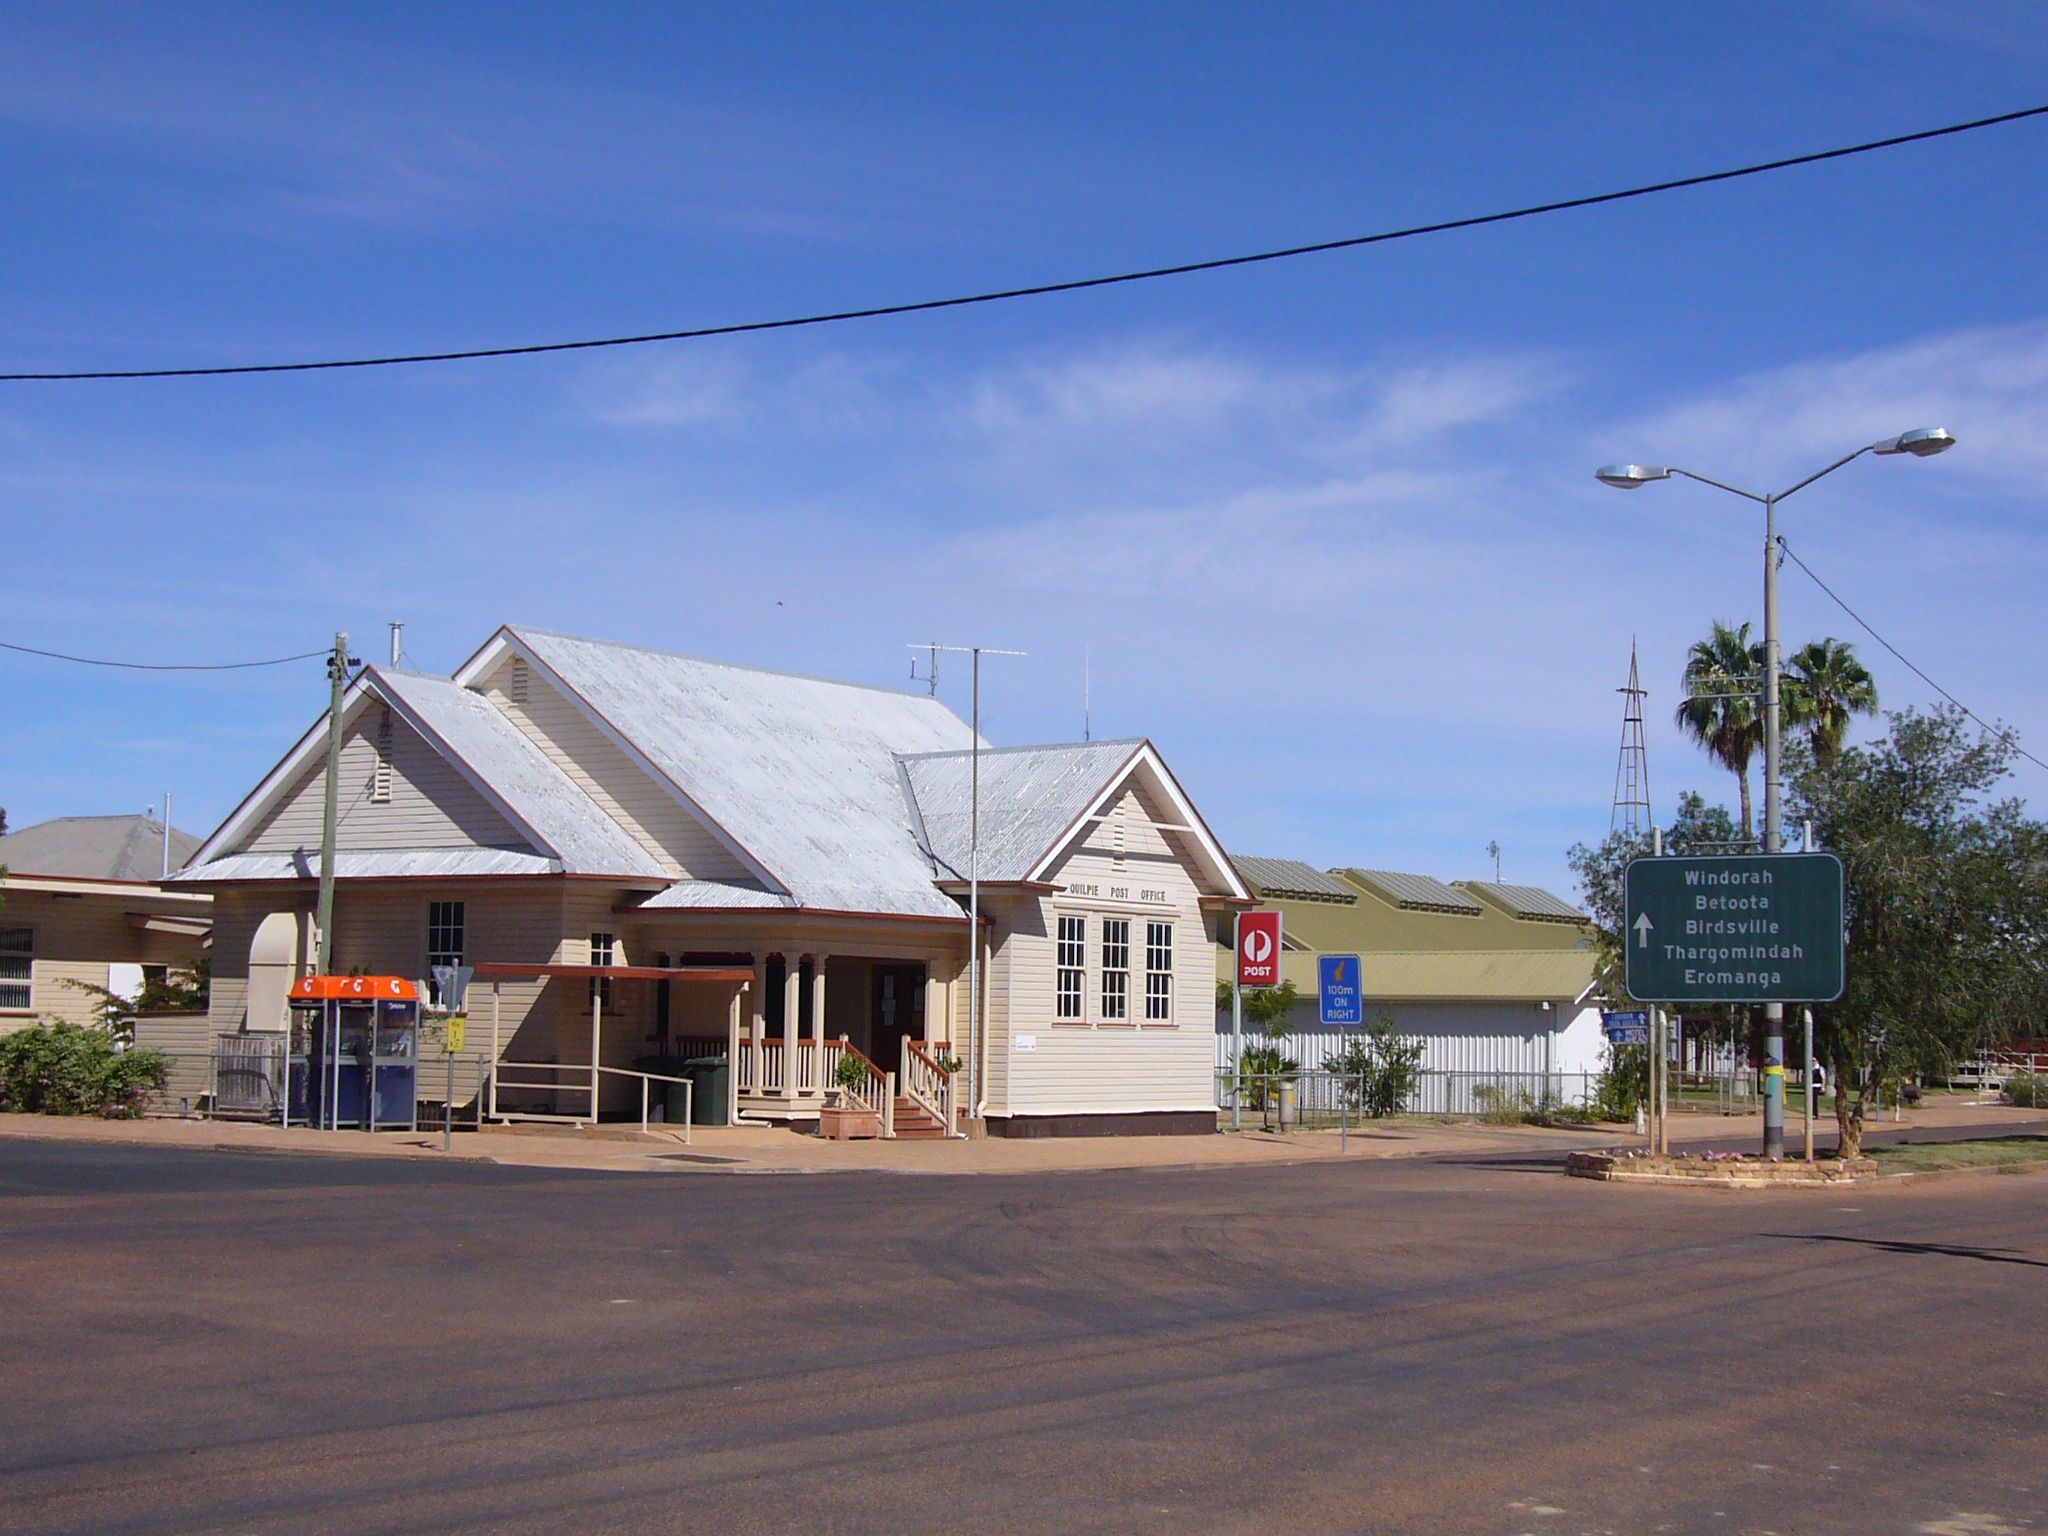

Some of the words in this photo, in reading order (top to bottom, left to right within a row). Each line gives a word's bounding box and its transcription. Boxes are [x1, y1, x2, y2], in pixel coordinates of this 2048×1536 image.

[1684, 870, 1773, 885] Windorah
[1069, 883, 1099, 896] QUILPIE
[1110, 887, 1129, 899] POST
[1140, 889, 1166, 902] OFFICE
[1695, 895, 1769, 910] Betoota
[1685, 919, 1780, 934] Birdsville
[1664, 944, 1803, 964] Thargomindah
[1243, 966, 1272, 976] POST
[1684, 969, 1781, 989] Eromanga
[1327, 985, 1353, 995] 100m
[1334, 997, 1347, 1007] ON
[1327, 1009, 1354, 1019] RIGHT
